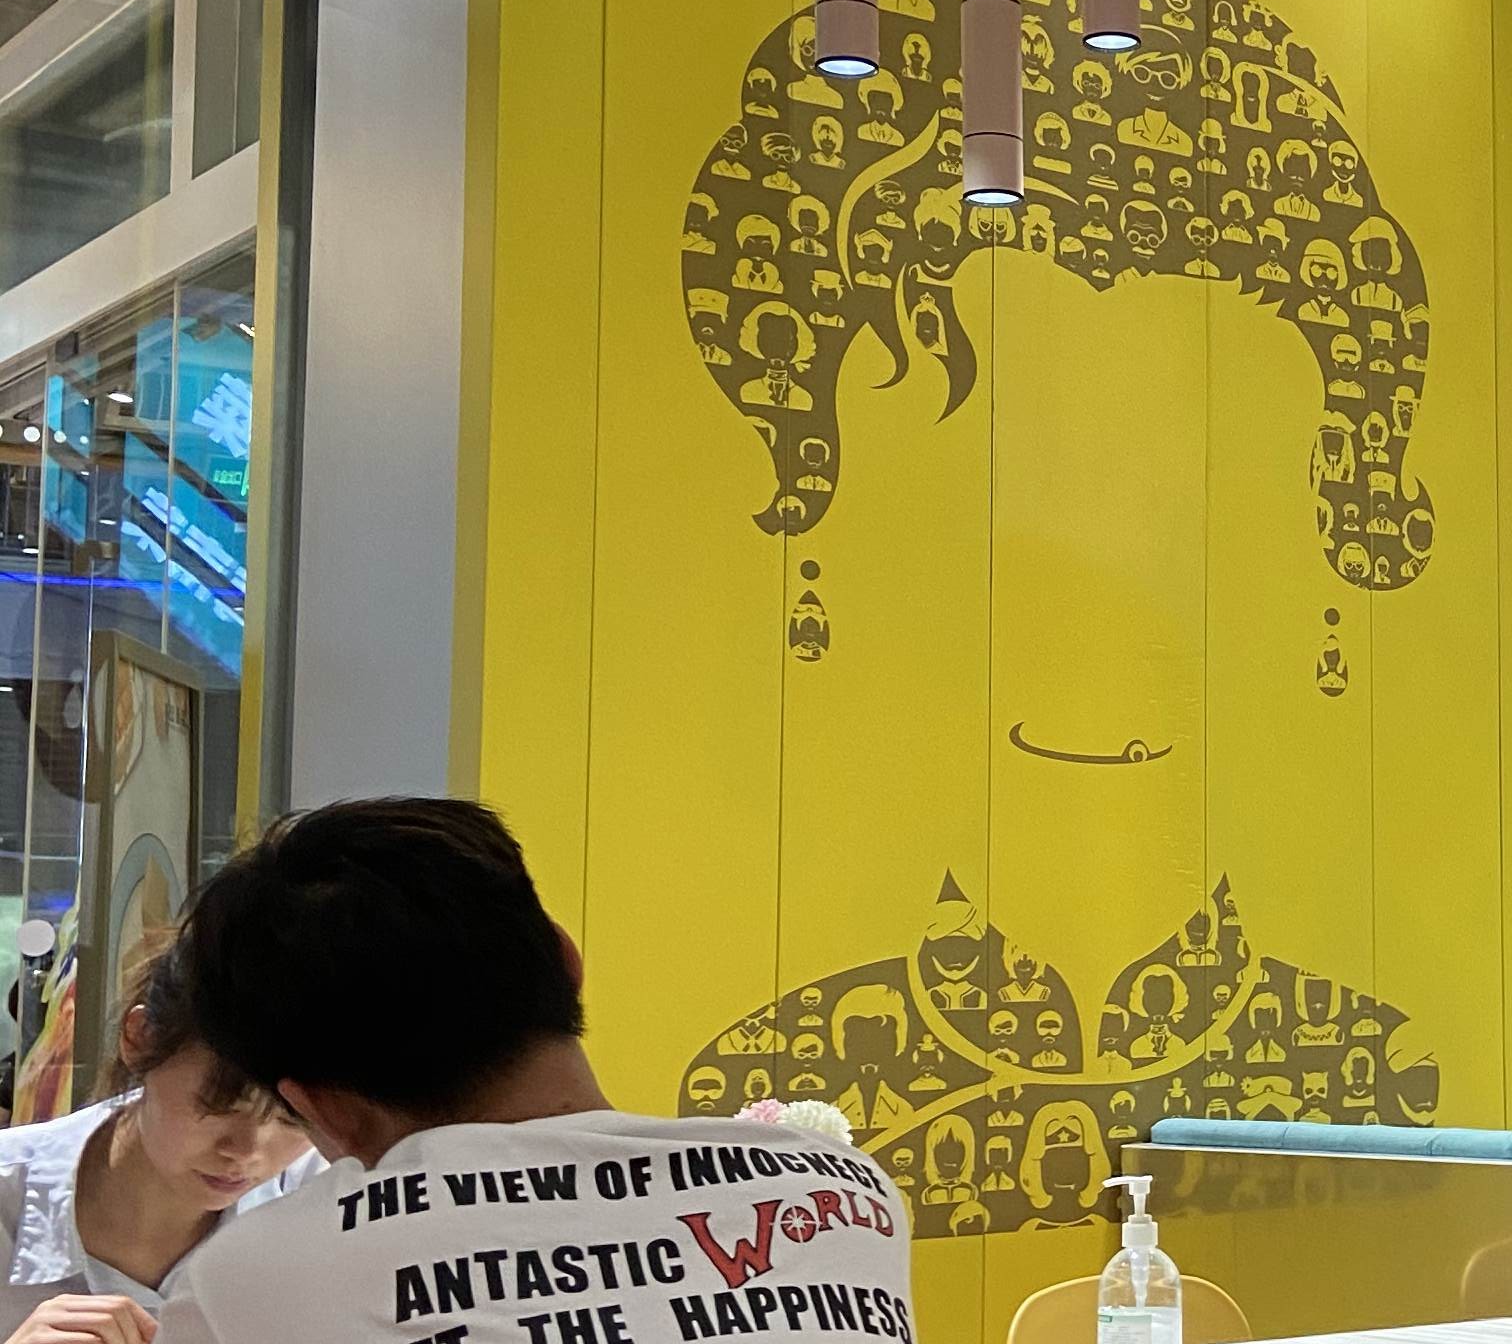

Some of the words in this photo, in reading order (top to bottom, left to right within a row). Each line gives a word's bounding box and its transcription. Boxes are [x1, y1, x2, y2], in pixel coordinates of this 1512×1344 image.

[338, 1172, 430, 1232] THE
[442, 1164, 578, 1207] VIEW
[594, 1156, 653, 1201] OF
[395, 1238, 686, 1324] ANTASTIC
